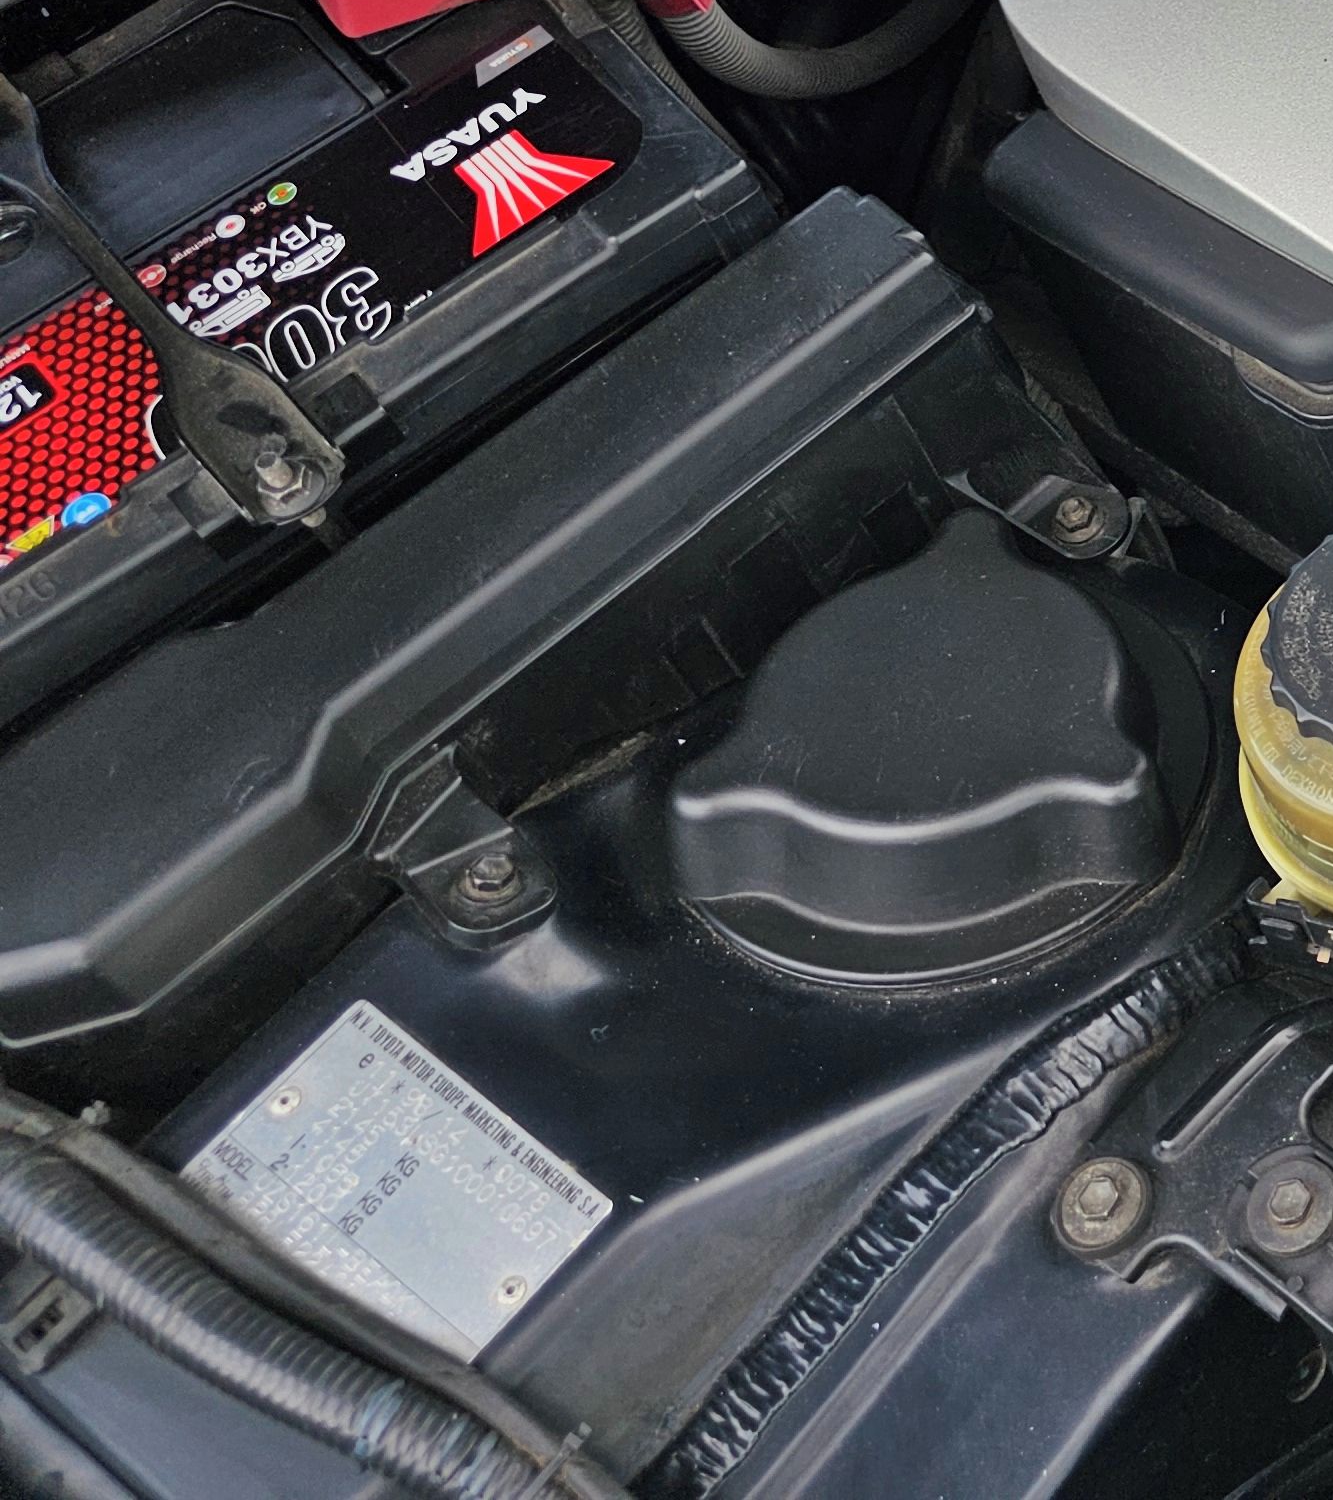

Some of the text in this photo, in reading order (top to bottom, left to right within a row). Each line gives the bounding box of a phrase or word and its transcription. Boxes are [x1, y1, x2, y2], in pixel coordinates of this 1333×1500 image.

[389, 87, 547, 182] YUASA
[170, 232, 217, 264] Recharge
[165, 214, 333, 326] YBX3031
[368, 1023, 407, 1058] TOYOTA
[398, 1048, 437, 1083] MOTOR
[428, 1072, 469, 1109] EUROPE
[460, 1100, 518, 1150] MARKETING
[509, 1140, 527, 1157] &
[518, 1147, 584, 1205] ENGINEERING
[210, 1137, 259, 1181] MODEL
[394, 1150, 422, 1177] KG
[375, 1169, 404, 1197] KG
[355, 1189, 384, 1217] KG
[336, 1207, 366, 1236] KG
